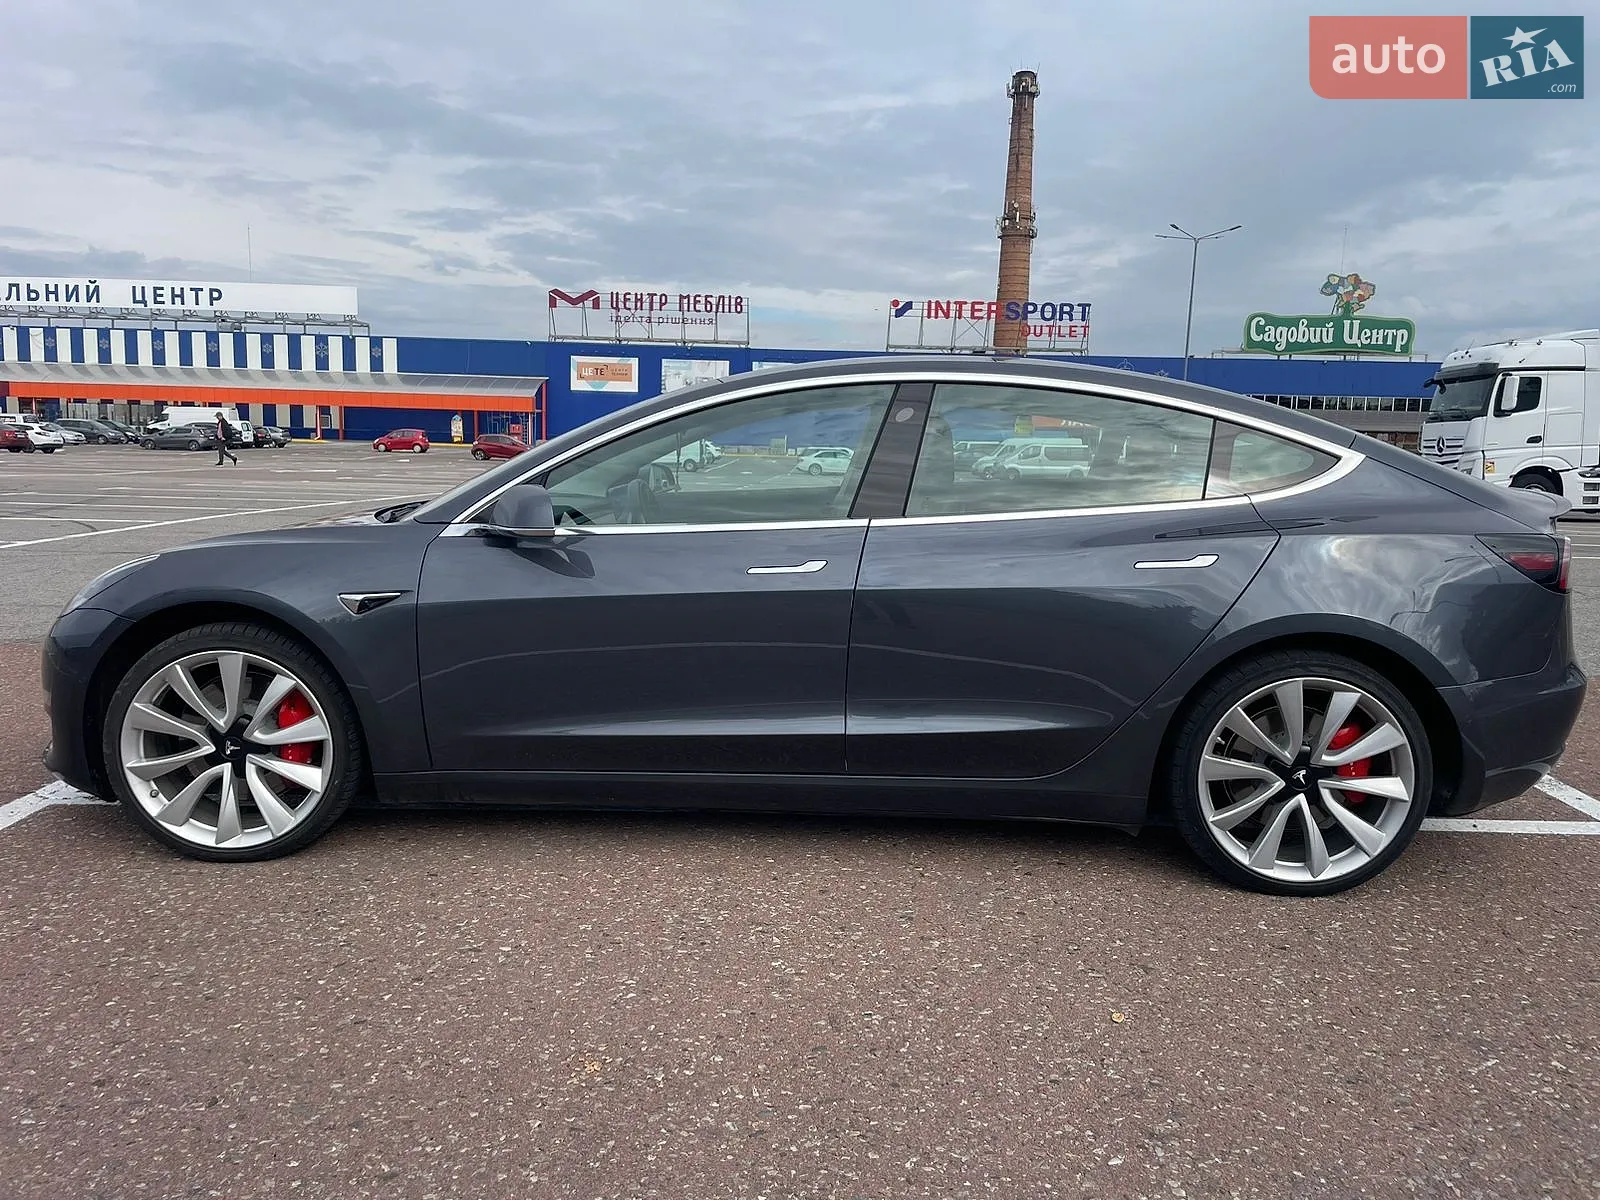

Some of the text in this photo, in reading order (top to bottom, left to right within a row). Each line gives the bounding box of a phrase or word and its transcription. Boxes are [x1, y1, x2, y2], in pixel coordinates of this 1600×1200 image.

[5, 280, 223, 307] ЛЬНИЙ ЦЕНТР
[610, 291, 743, 314] ЦЕНТР МЕБЛІВ
[926, 299, 1092, 322] INTERSPORT
[1020, 324, 1090, 338] OUTLET
[1249, 316, 1409, 352] Садовий Центр
